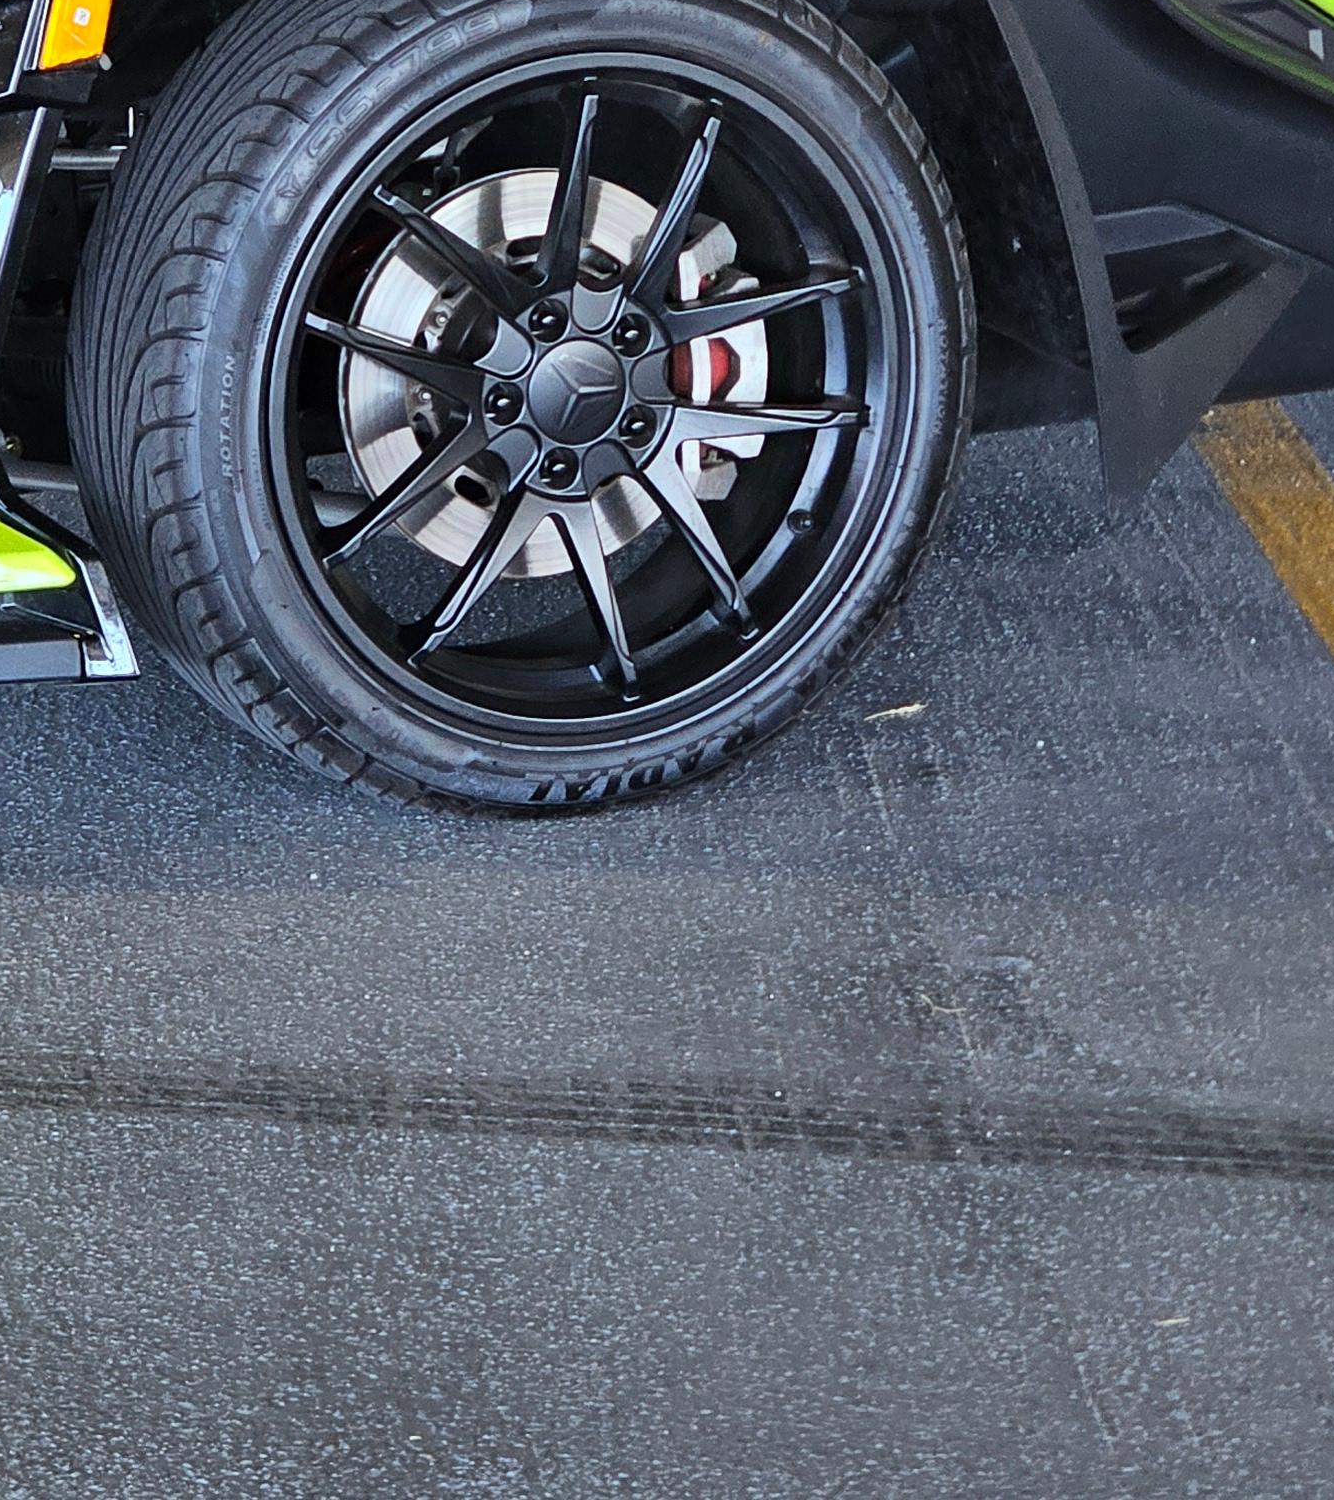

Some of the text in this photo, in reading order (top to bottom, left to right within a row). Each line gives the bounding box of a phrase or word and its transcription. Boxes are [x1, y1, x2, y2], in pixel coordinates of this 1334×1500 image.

[307, 8, 500, 166] SS-799
[219, 355, 236, 478] ROTATION
[525, 710, 757, 803] RADIAL
